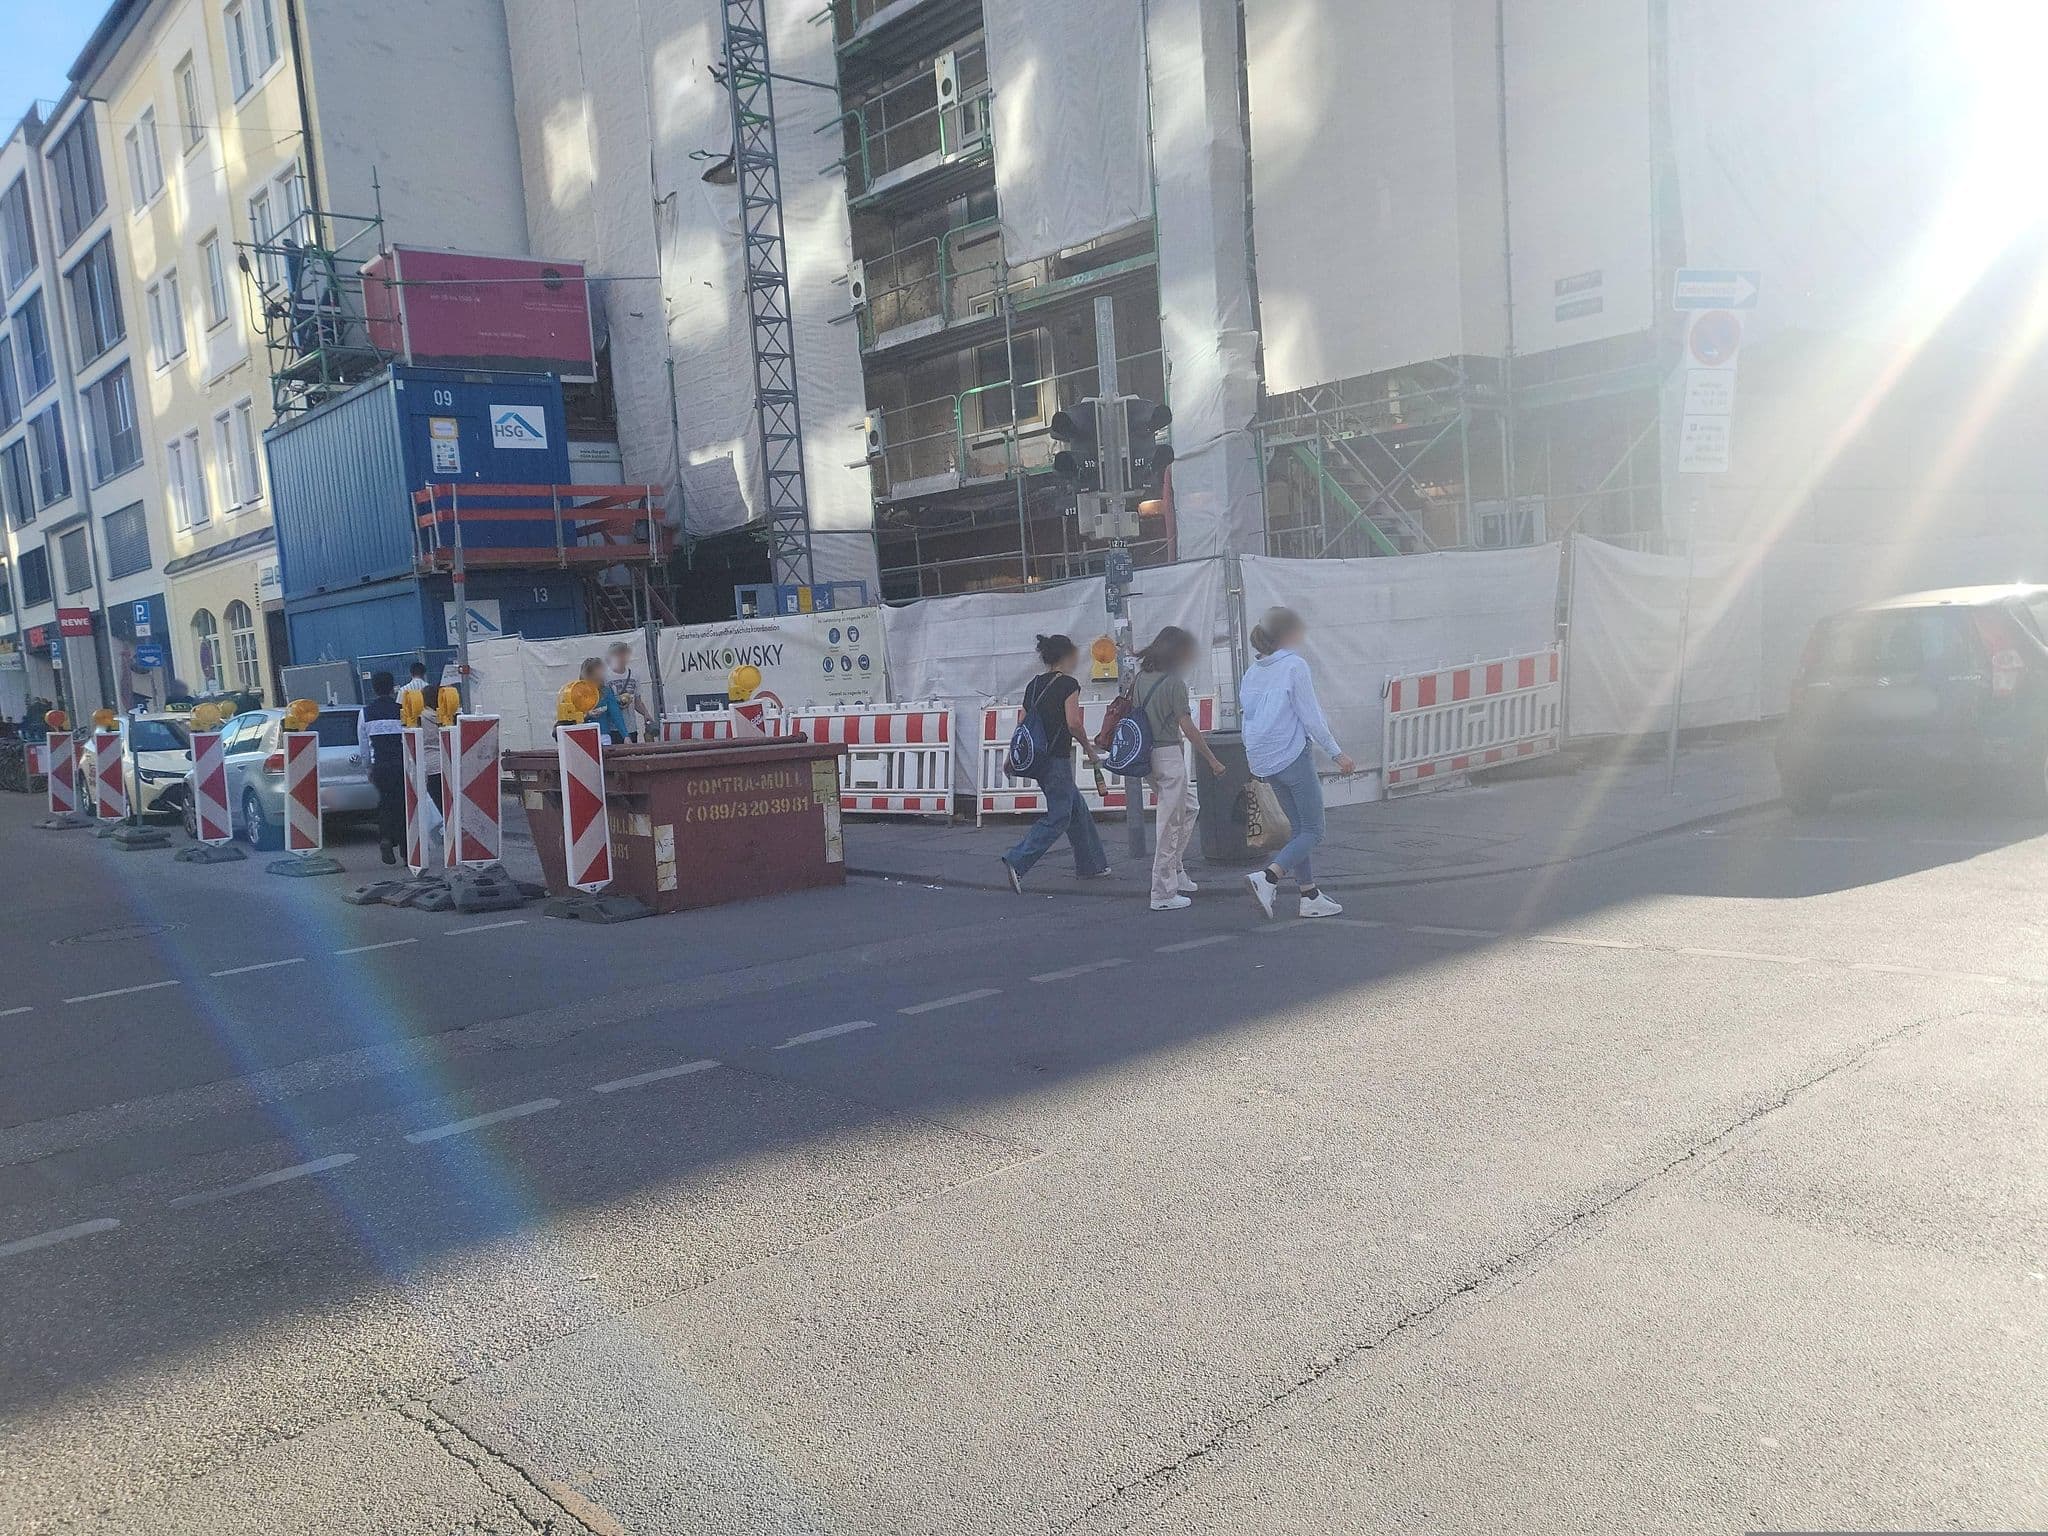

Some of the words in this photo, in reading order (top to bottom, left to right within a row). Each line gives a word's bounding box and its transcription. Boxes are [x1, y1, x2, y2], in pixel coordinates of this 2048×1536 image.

[433, 389, 452, 406] 09
[494, 424, 524, 438] HSG
[532, 587, 549, 603] 13
[61, 617, 90, 628] REWE
[448, 620, 479, 634] HG
[680, 643, 783, 673] JANKOWSKY
